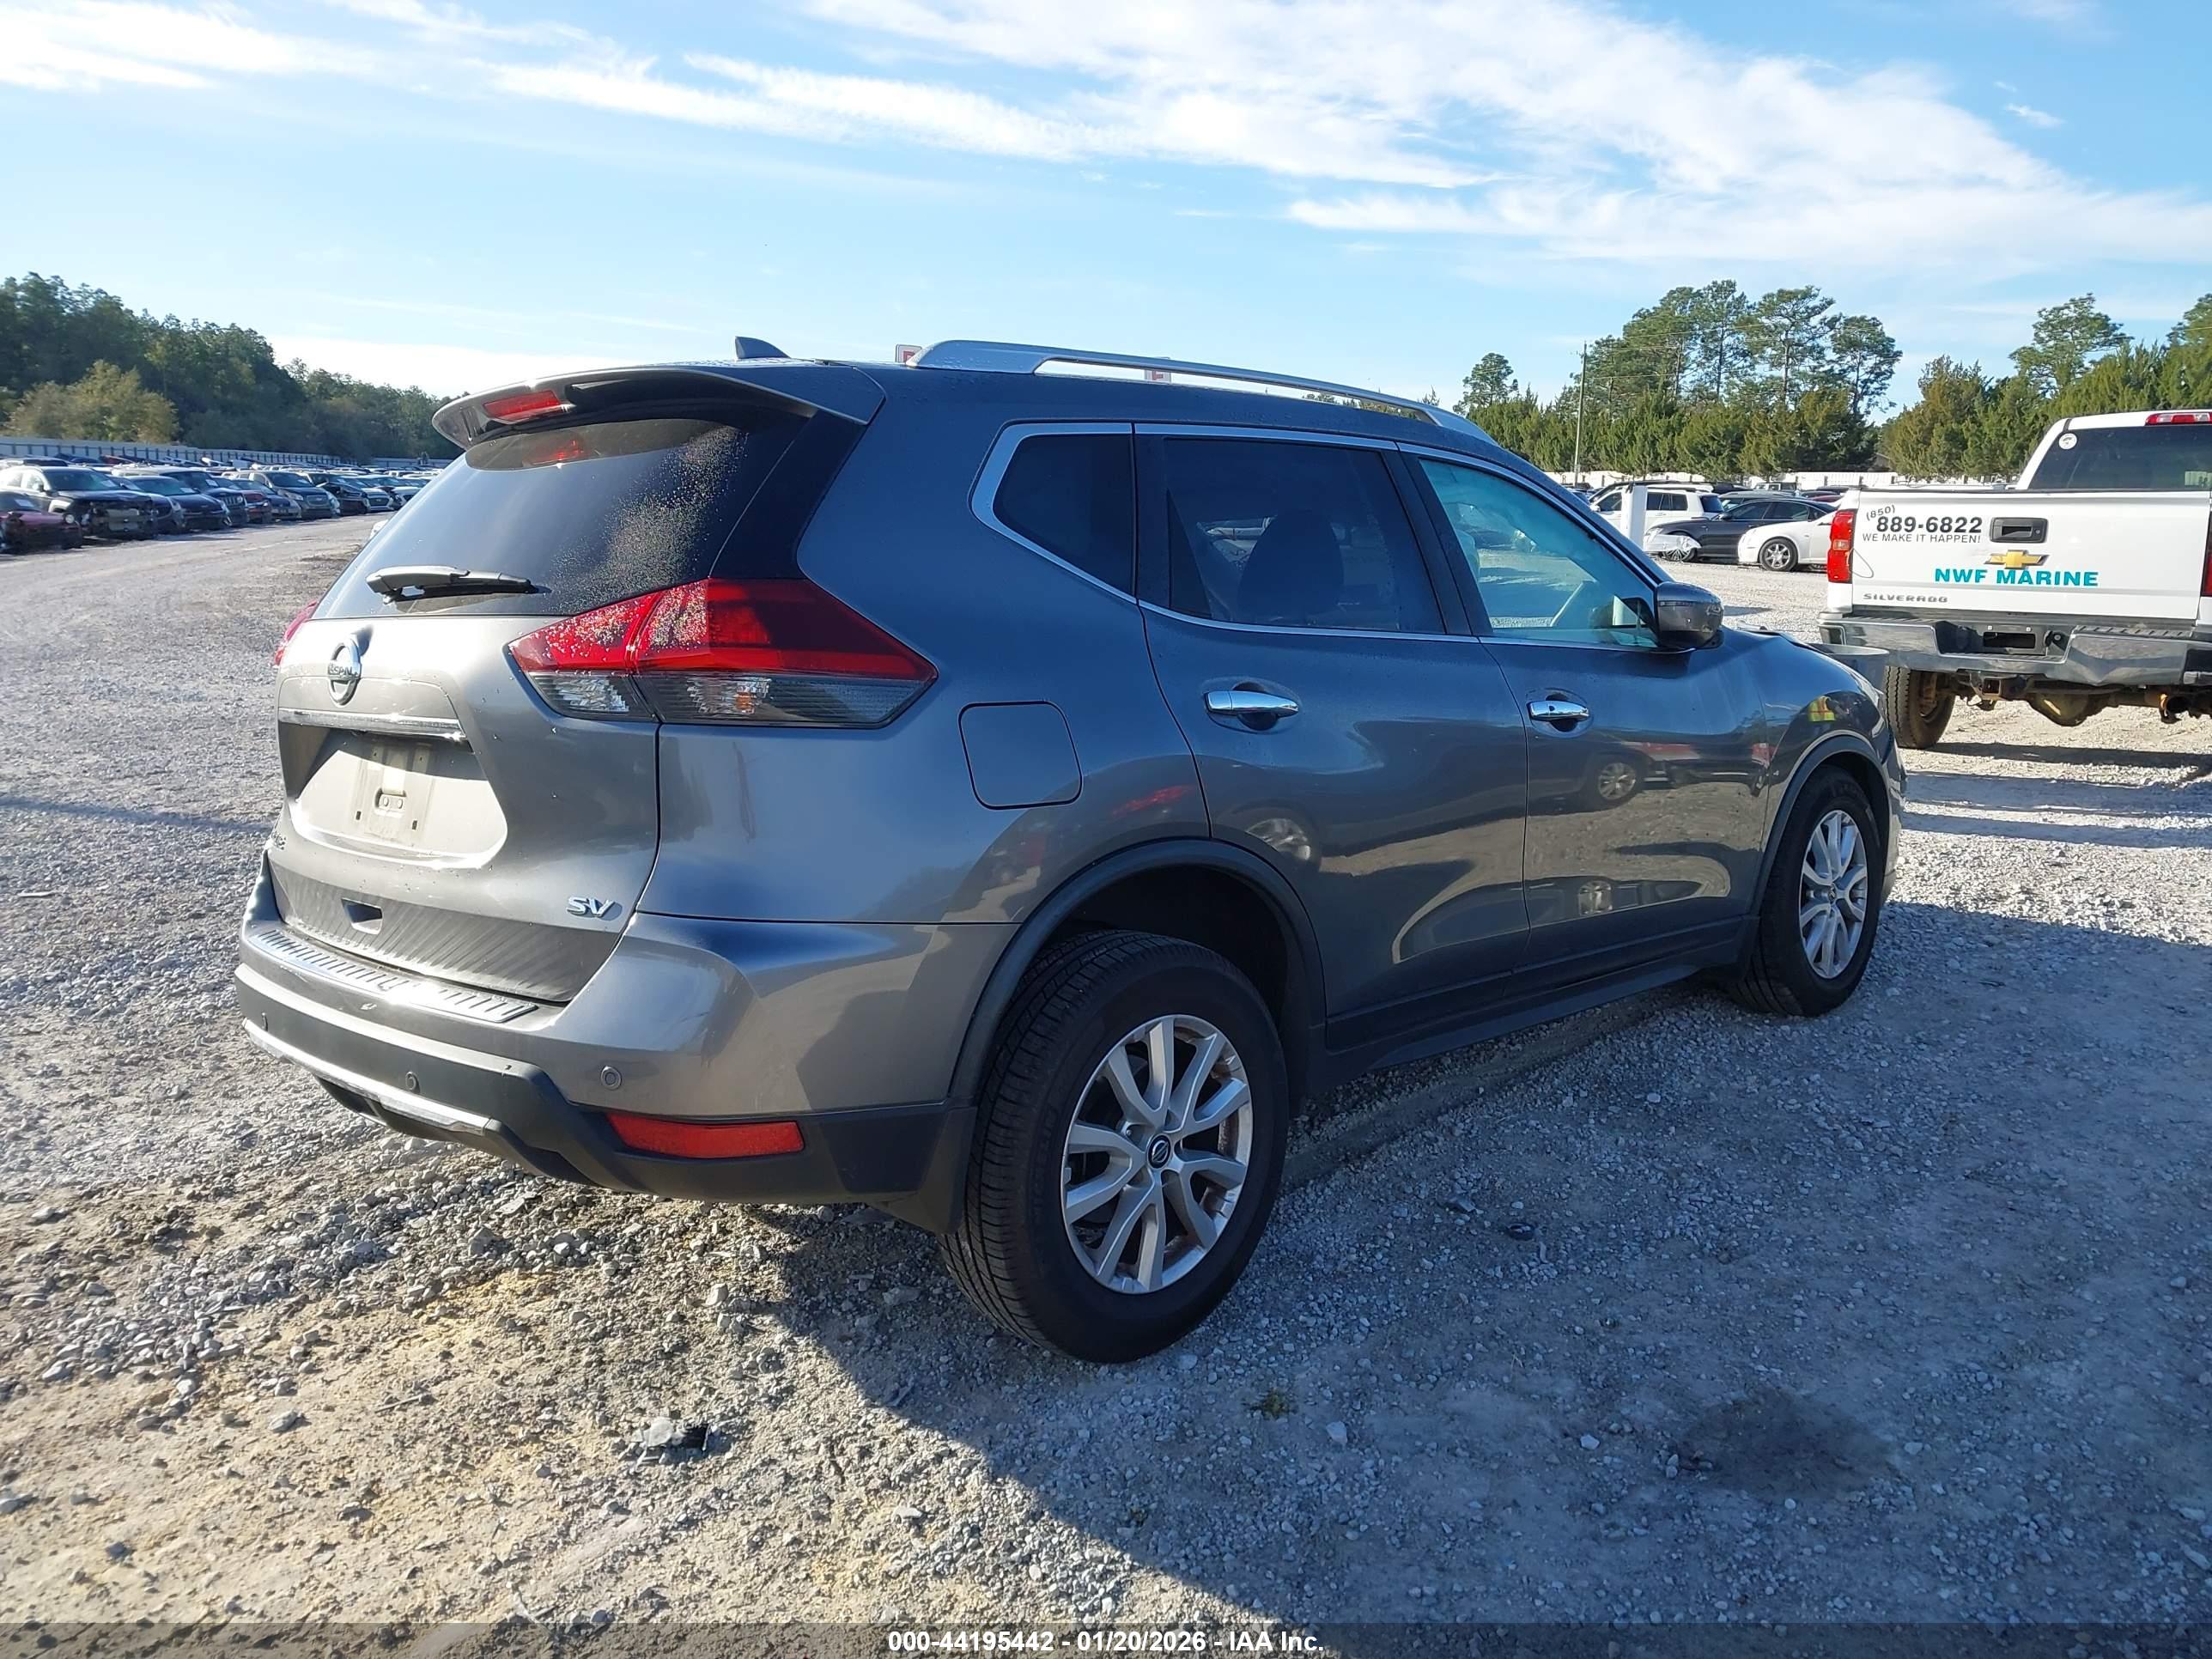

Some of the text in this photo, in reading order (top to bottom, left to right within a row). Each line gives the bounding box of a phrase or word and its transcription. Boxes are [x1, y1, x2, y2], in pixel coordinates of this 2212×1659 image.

[1866, 504, 1896, 521] (850)
[1876, 516, 1983, 533] 889-6822
[1863, 533, 1981, 544] WE MAKE IT HAPPEN!
[1935, 568, 2100, 586] NWF MARINE
[1863, 593, 1948, 603] SILVERADO
[566, 896, 617, 917] SV
